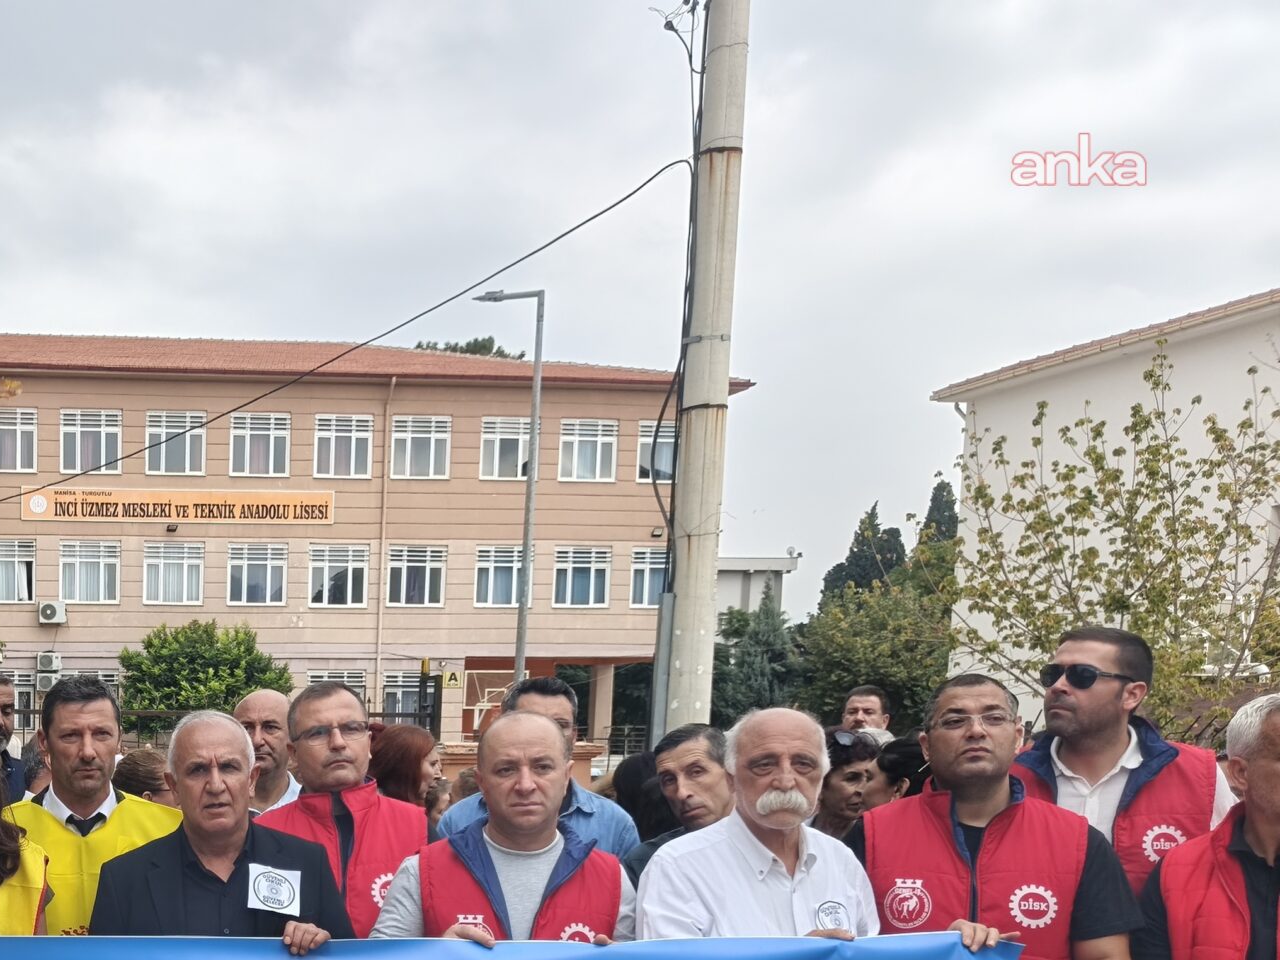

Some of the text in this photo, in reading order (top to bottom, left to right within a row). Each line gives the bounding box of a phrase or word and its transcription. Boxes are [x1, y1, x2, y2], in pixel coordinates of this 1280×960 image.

[54, 498, 329, 520] İNCİ ÜZMEZ MESLEKİ VE TEKNİK ANADOLU LİSESİ
[448, 672, 458, 682] A
[1020, 898, 1049, 911] DİSK
